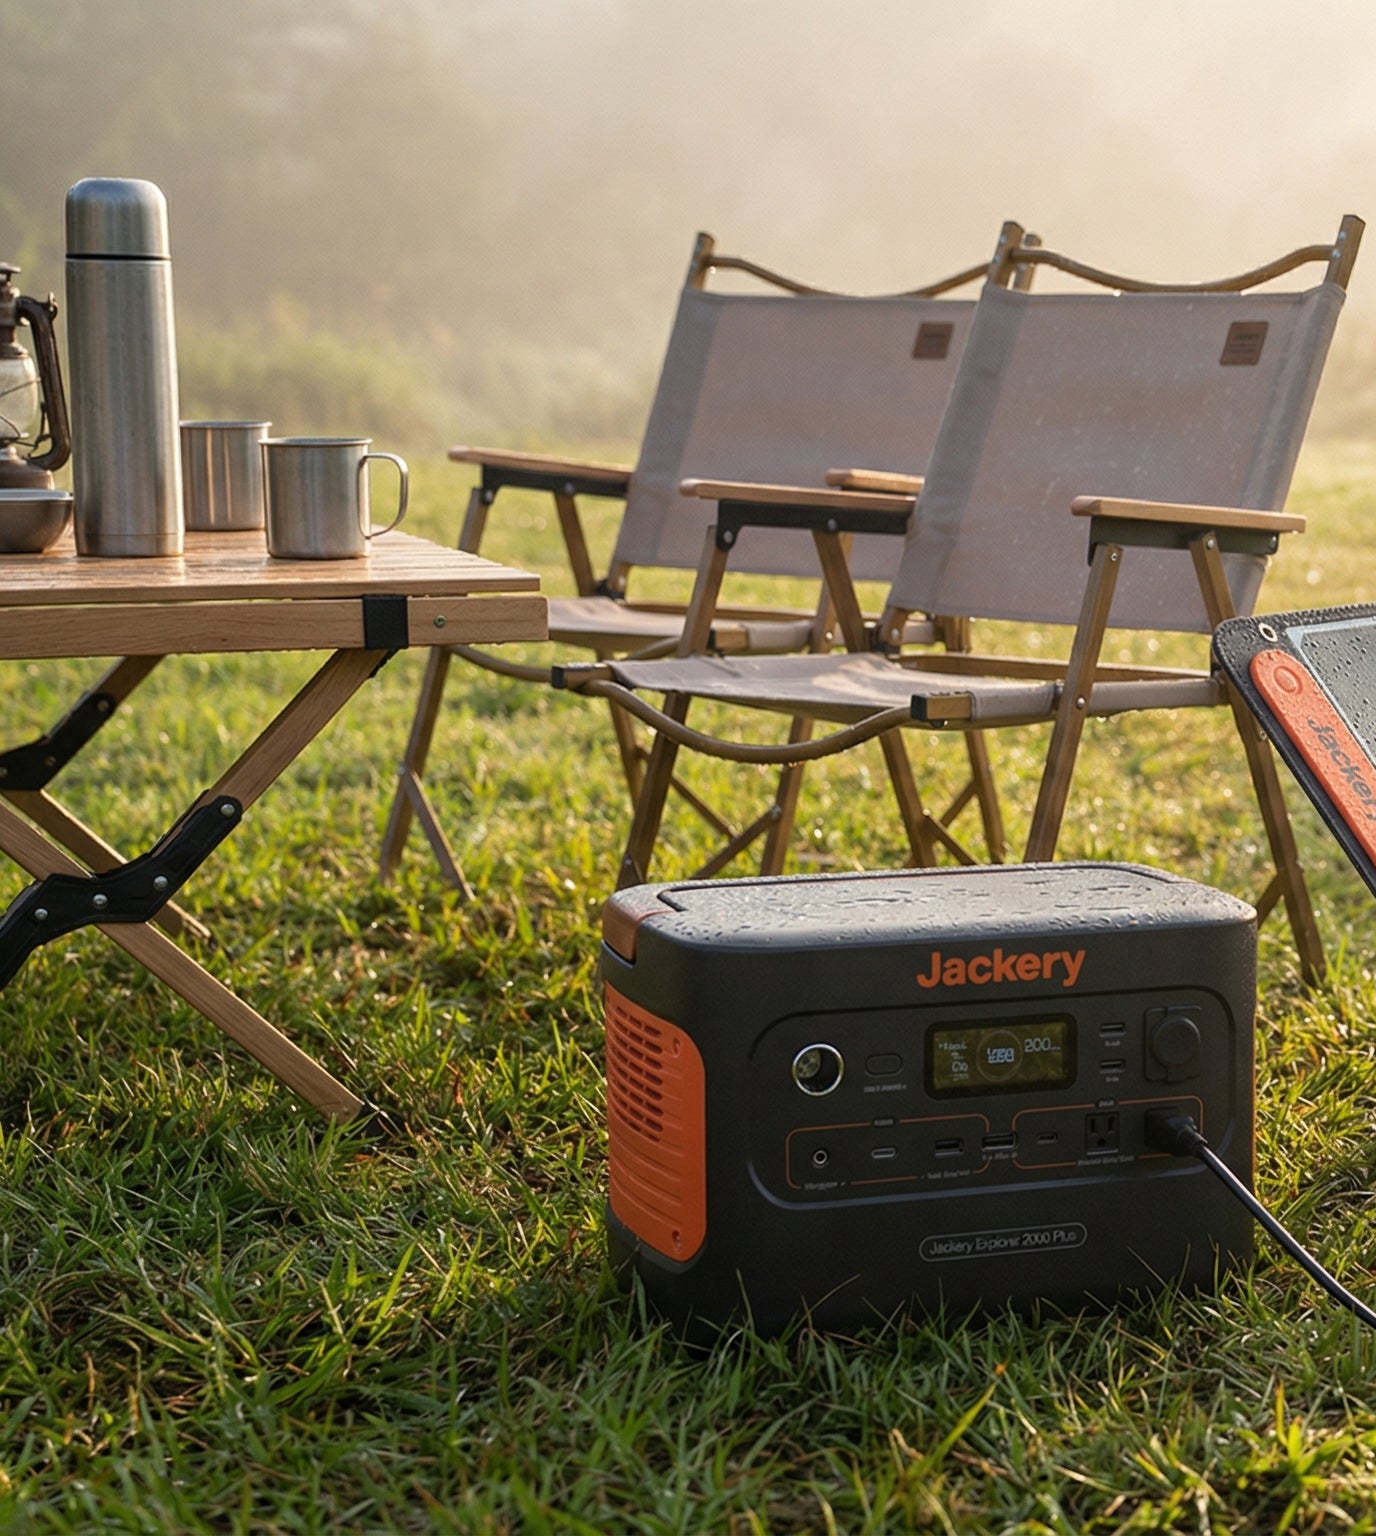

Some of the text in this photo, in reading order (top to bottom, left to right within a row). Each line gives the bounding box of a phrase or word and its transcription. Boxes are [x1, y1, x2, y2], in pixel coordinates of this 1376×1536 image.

[916, 948, 1086, 988] Jackery
[1024, 1037, 1051, 1053] 200
[929, 1240, 973, 1256] Jackery
[1022, 1231, 1051, 1246] 2000
